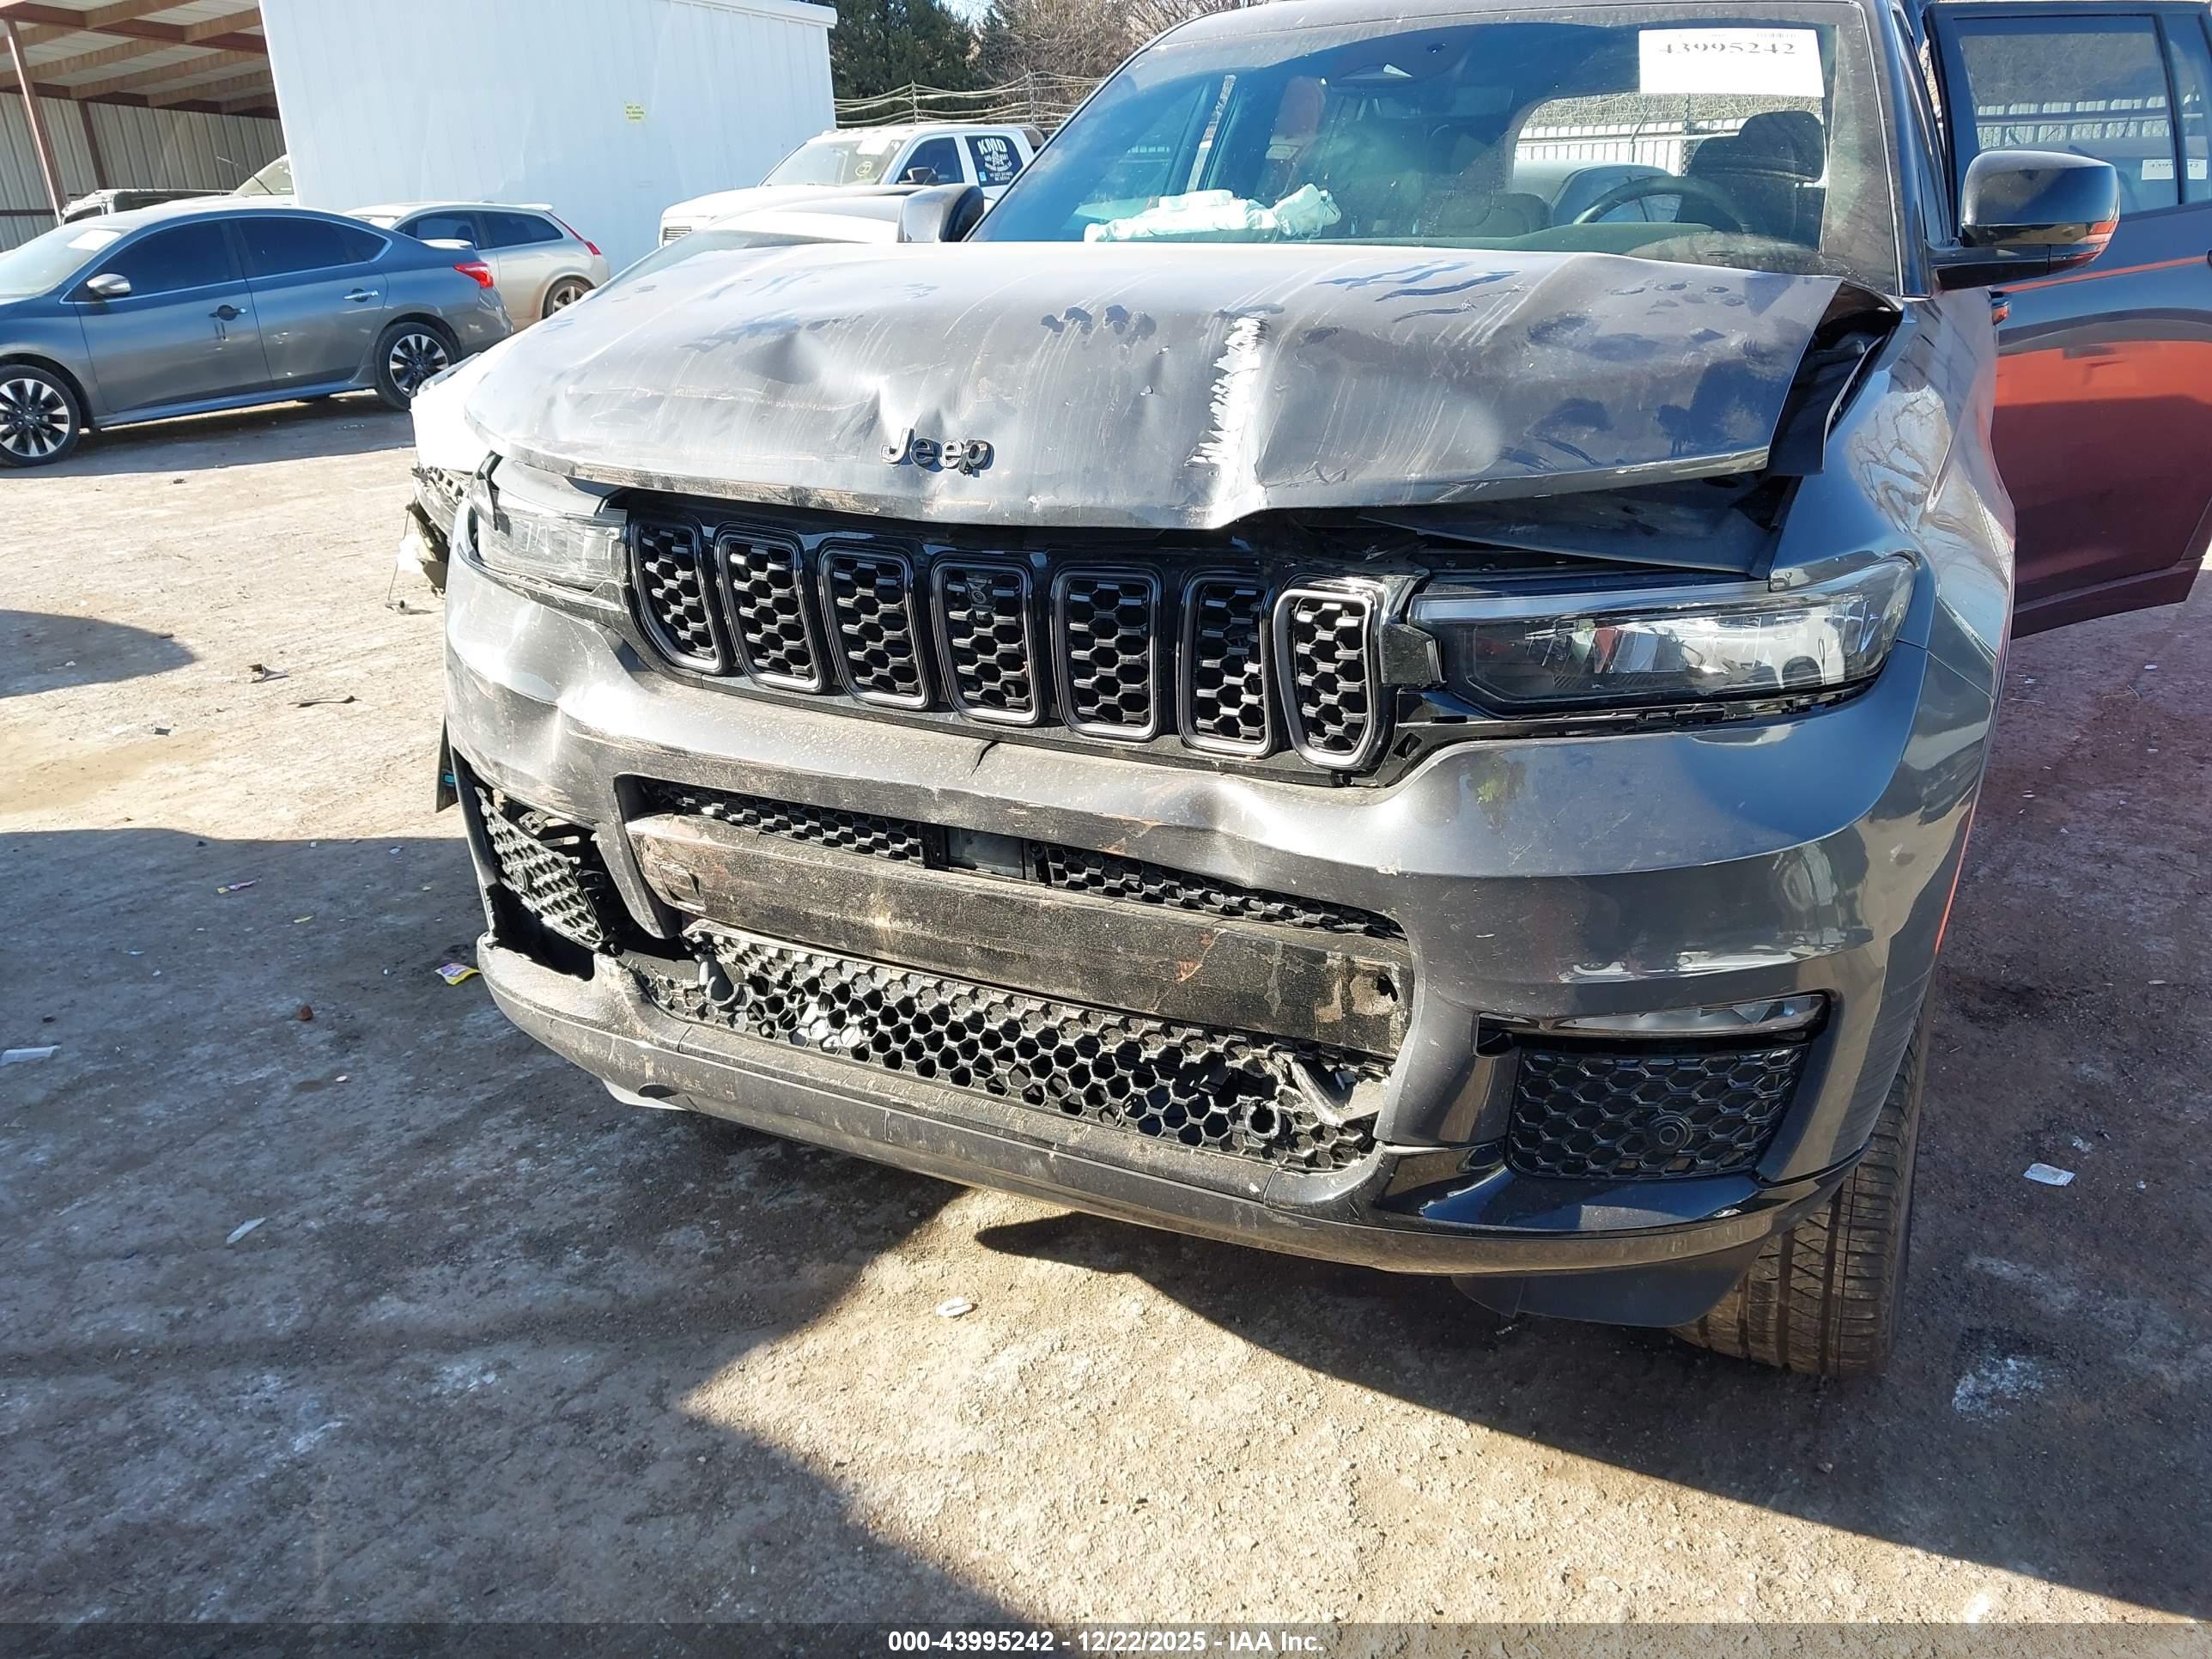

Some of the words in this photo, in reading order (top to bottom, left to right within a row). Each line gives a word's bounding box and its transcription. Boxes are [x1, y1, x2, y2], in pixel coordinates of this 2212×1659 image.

[1659, 42, 1796, 55] 43995242
[977, 137, 1007, 155] KMD
[880, 428, 994, 477] Jeep
